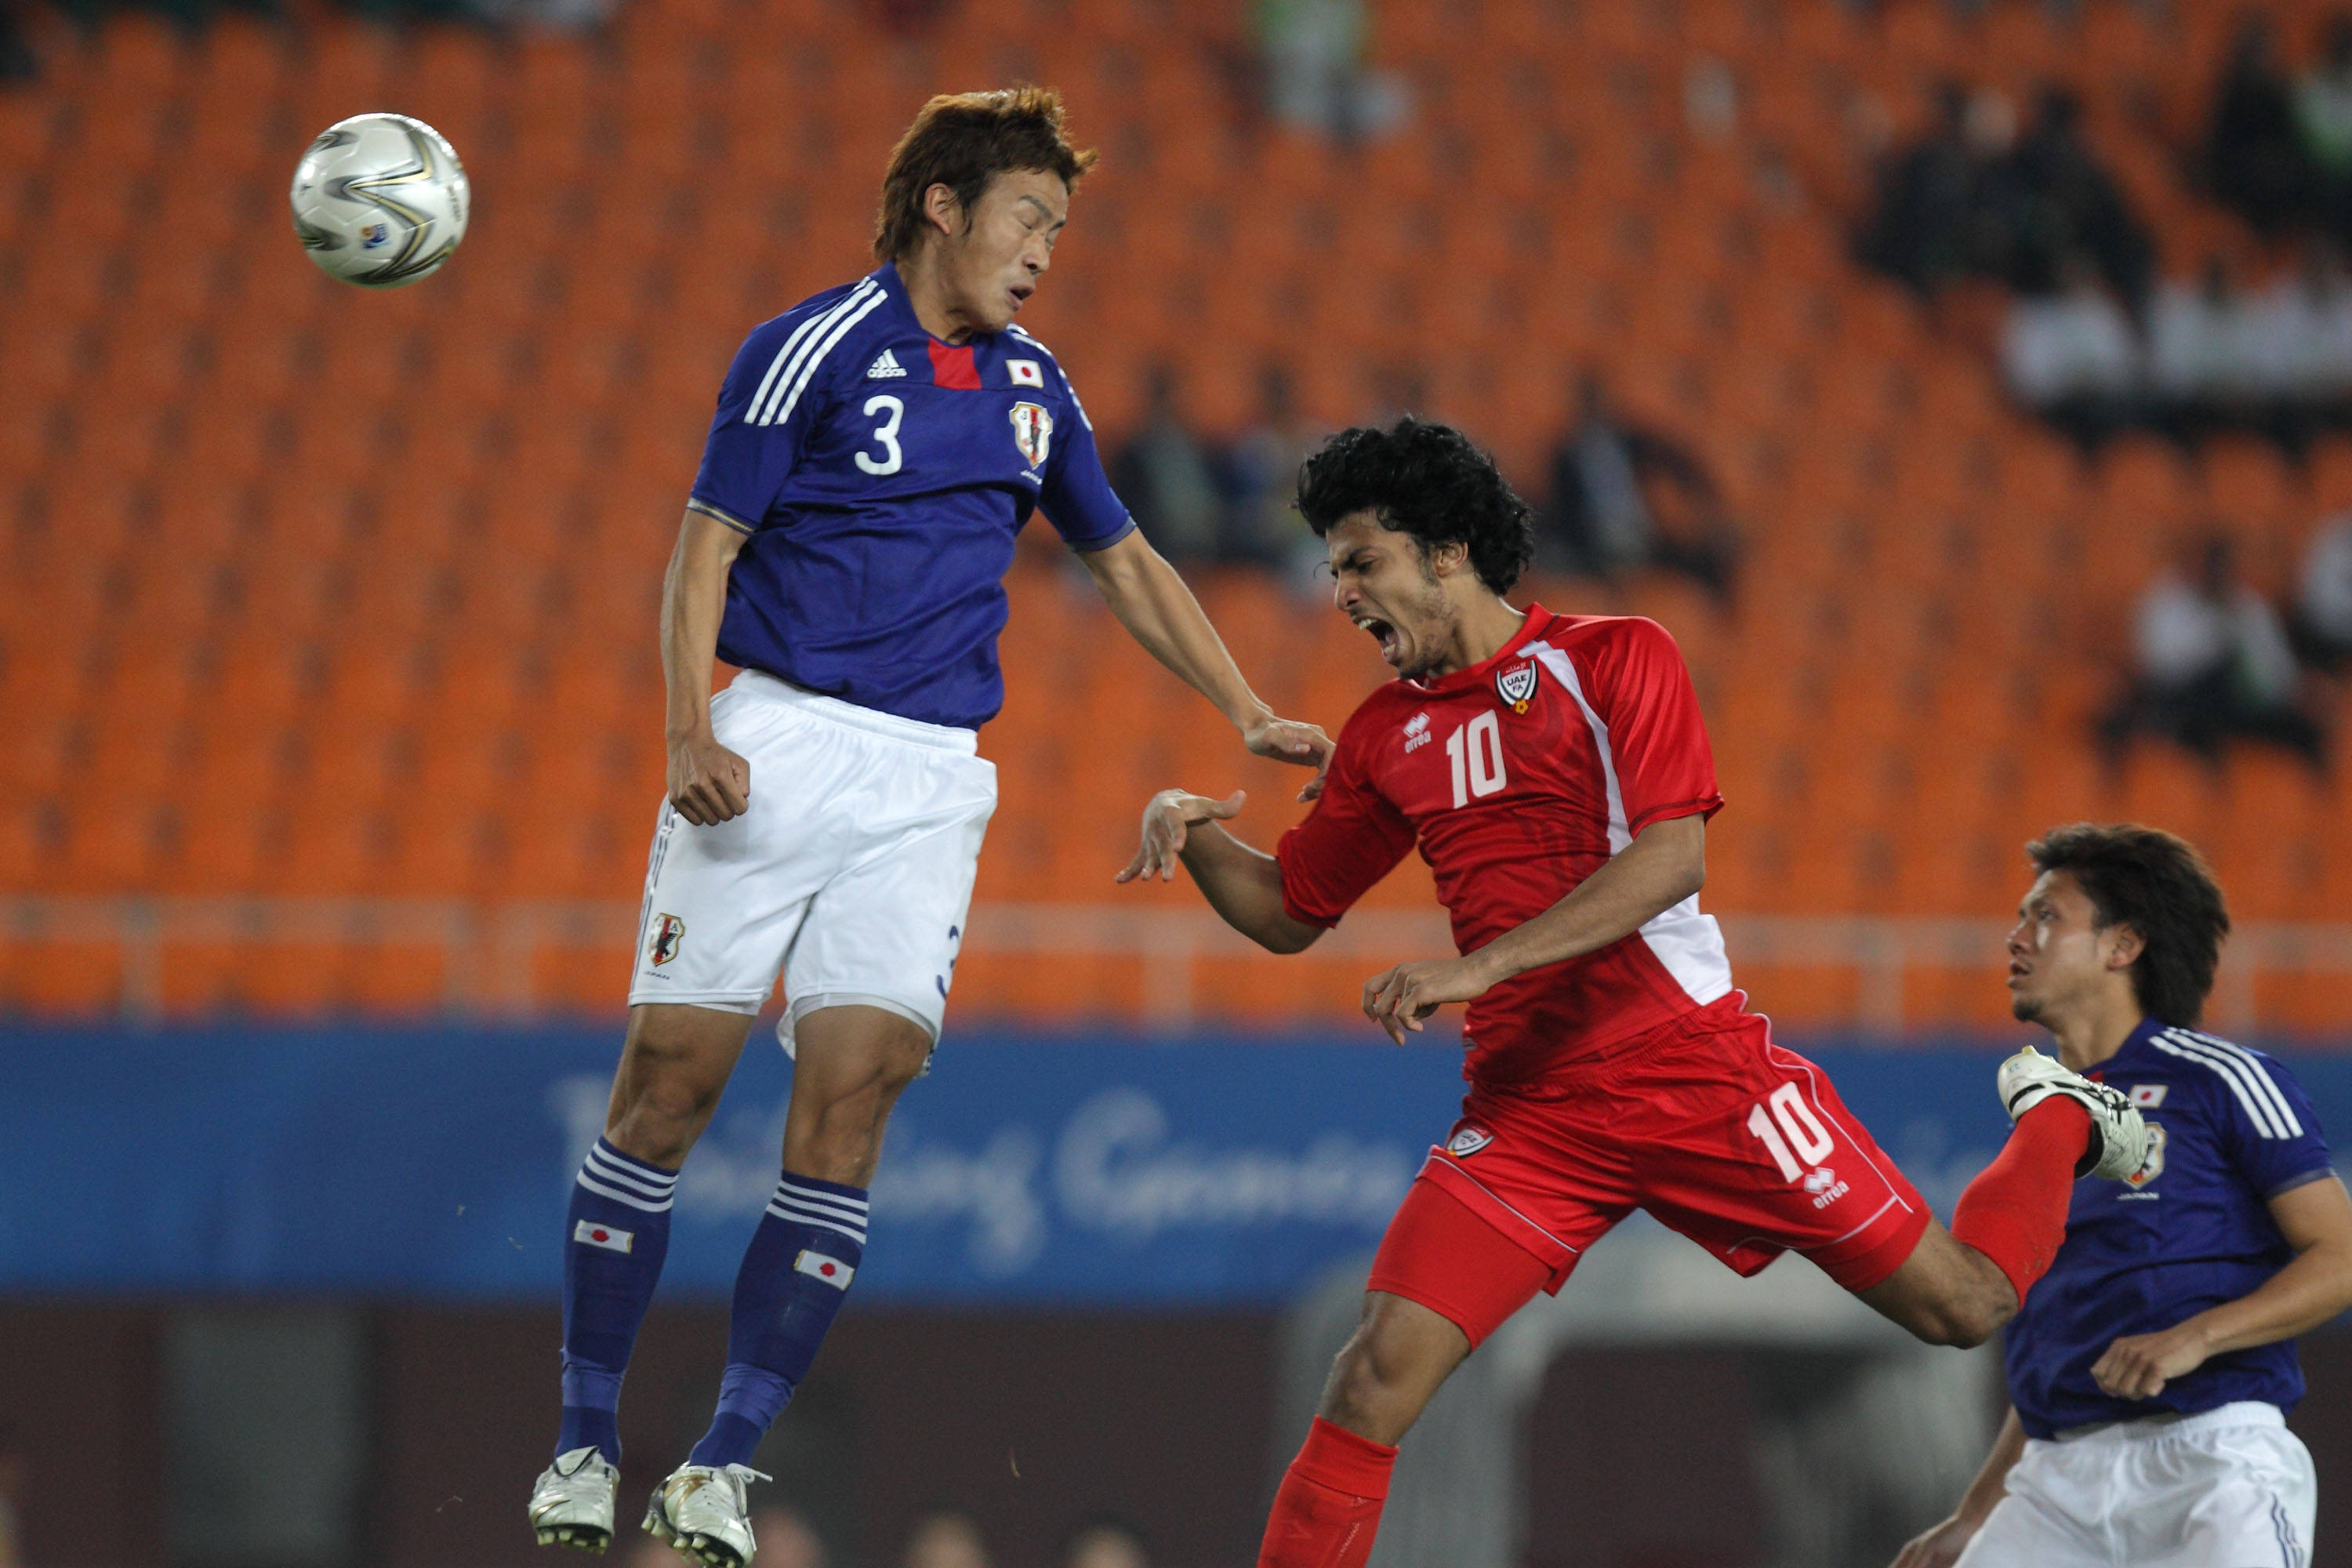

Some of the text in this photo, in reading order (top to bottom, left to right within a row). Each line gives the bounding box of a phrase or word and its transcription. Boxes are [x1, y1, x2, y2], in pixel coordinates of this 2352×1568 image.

[867, 368, 907, 379] adidas
[855, 395, 904, 475] 3
[1507, 674, 1527, 686] UAE
[1512, 684, 1523, 692] FA
[1446, 709, 1507, 809] 10
[1747, 1080, 1835, 1185] 10
